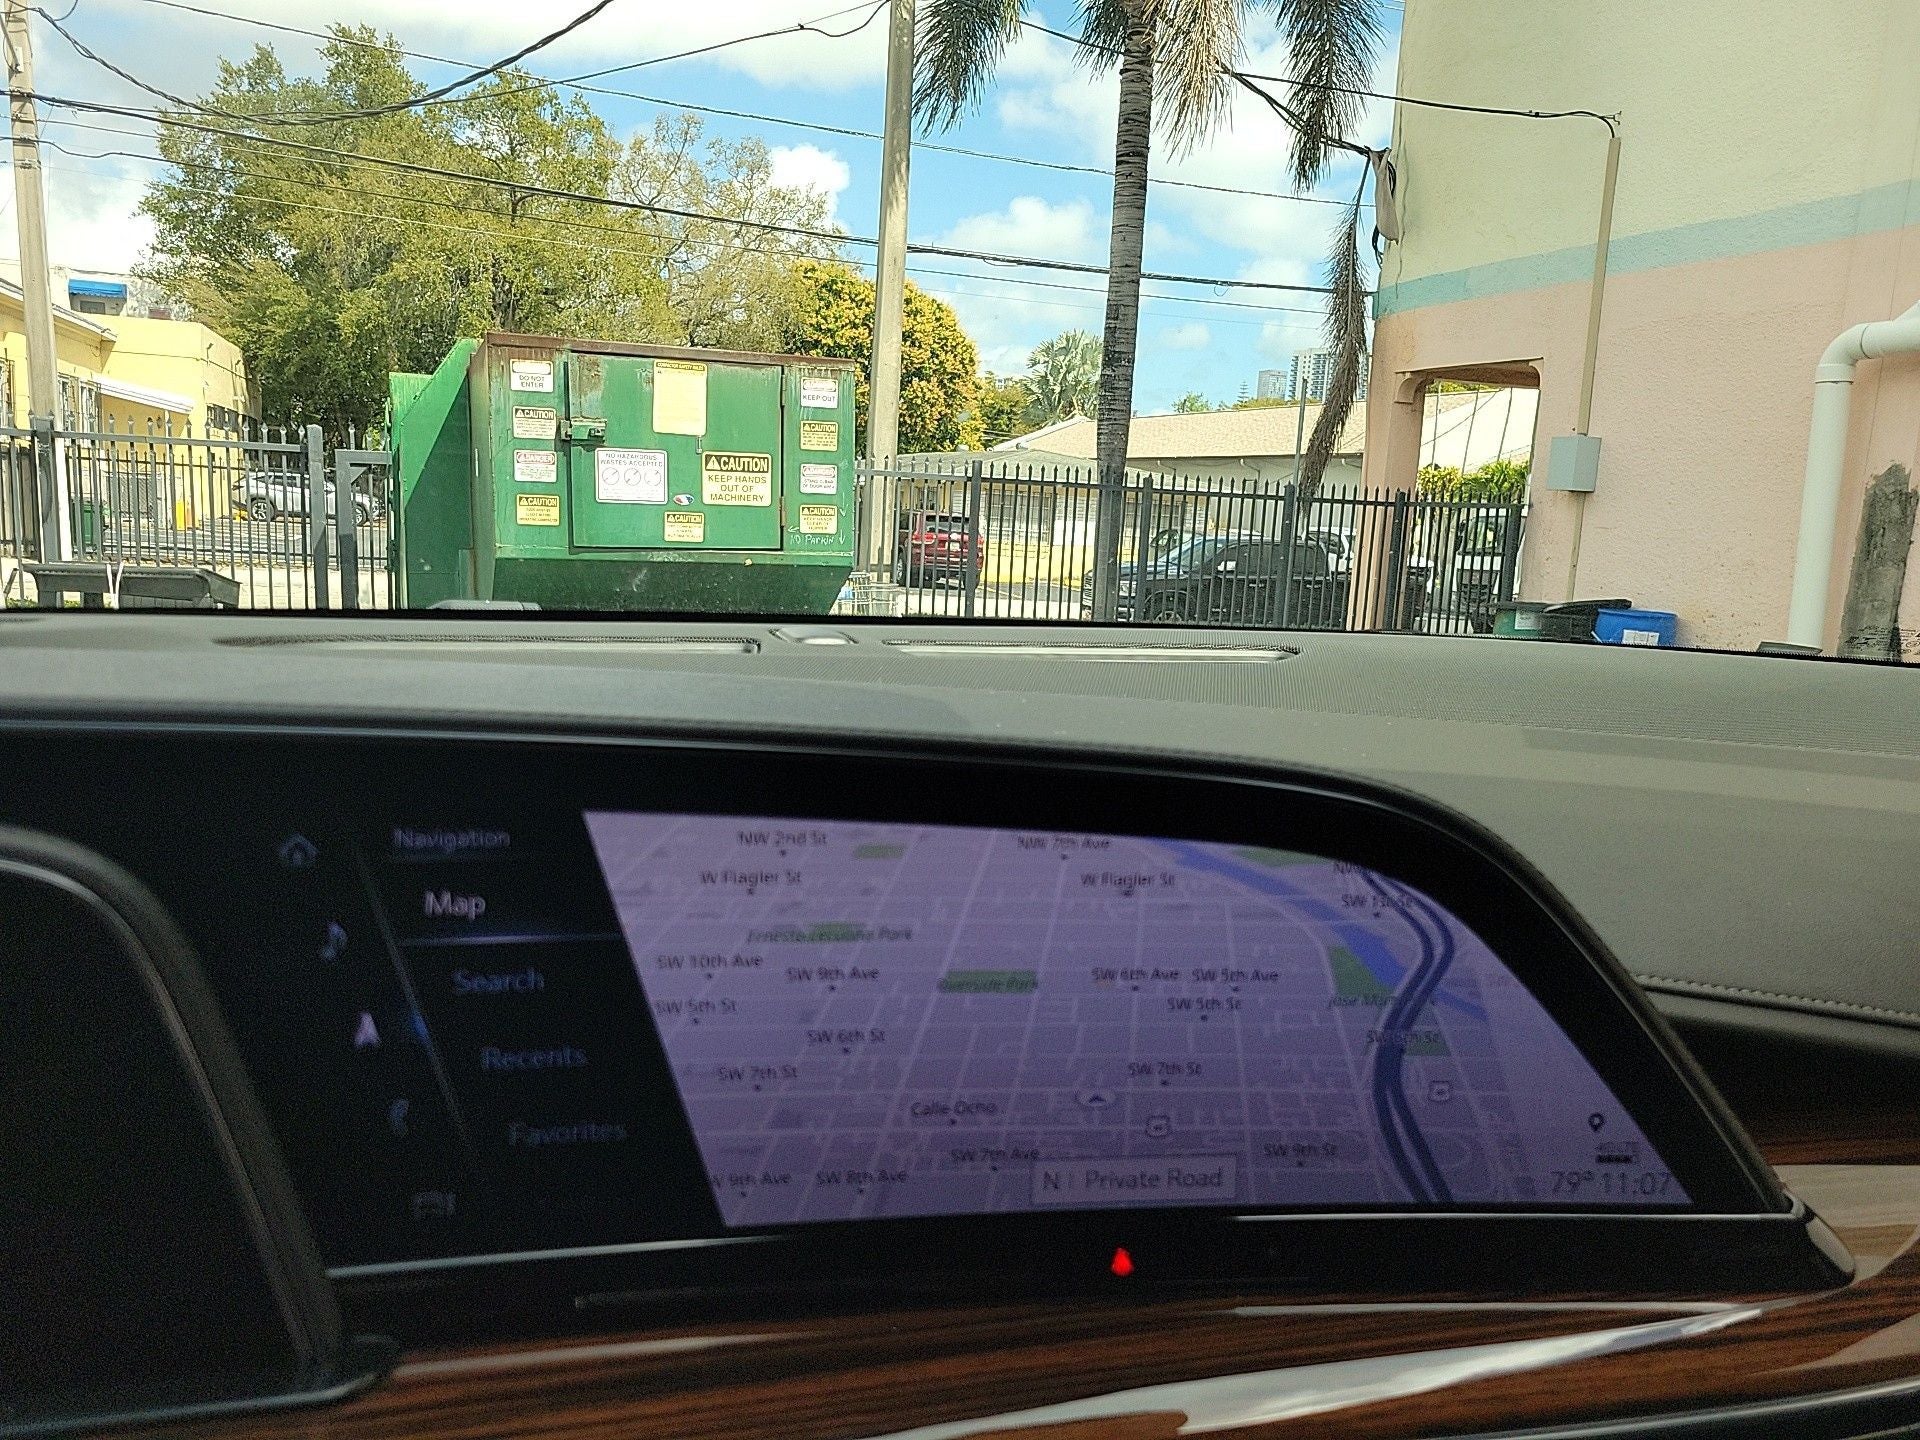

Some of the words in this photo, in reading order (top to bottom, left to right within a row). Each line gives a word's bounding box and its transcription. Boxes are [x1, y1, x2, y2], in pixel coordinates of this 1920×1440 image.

[524, 409, 554, 419] CAUTION
[810, 424, 836, 432] CAUTION
[720, 456, 768, 472] CAUTION
[707, 474, 733, 483] KEEP
[735, 475, 767, 484] HANDS
[720, 484, 740, 492] OUT
[741, 484, 754, 492] OF
[527, 497, 557, 506] CAUTION
[710, 493, 764, 502] MACHINERY
[674, 514, 702, 523] CAUTION
[809, 507, 835, 516] CAUTION
[394, 828, 511, 853] Navigation
[737, 831, 770, 846] NW
[773, 830, 807, 846] 2nd
[810, 830, 827, 846] St
[1080, 836, 1112, 850] Ave
[699, 870, 718, 884] W
[720, 869, 779, 888] Flagler
[784, 869, 803, 884] St
[1080, 873, 1097, 887] W
[1100, 871, 1155, 889] Flagler
[1159, 872, 1176, 887] St
[423, 890, 487, 920] Map
[1341, 893, 1367, 908] SW
[656, 955, 684, 970] SW
[689, 954, 727, 969] 10th
[731, 954, 765, 969] Ave
[452, 967, 546, 995] Search
[785, 967, 813, 982] SW
[817, 966, 845, 981] 9th
[849, 966, 881, 981] Ave
[1091, 967, 1118, 982] SW
[1150, 967, 1181, 981] Ave
[1191, 968, 1218, 983] SW
[1250, 968, 1279, 983] Ave
[654, 1000, 682, 1015] SW
[686, 998, 716, 1014] 5th
[720, 998, 738, 1013] St
[1166, 997, 1192, 1013] SW
[1225, 997, 1242, 1012] St
[806, 1029, 834, 1046] SW
[836, 1028, 865, 1044] 6th
[868, 1028, 886, 1043] St
[480, 1046, 588, 1072] Recents
[717, 1066, 744, 1082] SW
[749, 1065, 777, 1081] 7th
[781, 1064, 798, 1080] St
[1127, 1062, 1153, 1077] SW
[1157, 1061, 1184, 1076] 7th
[1186, 1062, 1203, 1076] St
[910, 1101, 950, 1118] Calle
[953, 1100, 999, 1116] Ocho
[508, 1122, 629, 1147] Favorites
[950, 1148, 976, 1164] SW
[979, 1147, 1007, 1162] 7th
[1010, 1146, 1041, 1161] Ave
[1263, 1142, 1289, 1158] SW
[1321, 1142, 1338, 1157] St
[760, 1171, 792, 1187] Ave
[815, 1170, 842, 1186] SW
[877, 1169, 909, 1184] Ave
[1042, 1171, 1061, 1191] N
[1085, 1168, 1161, 1191] Private
[1166, 1166, 1224, 1188] Road
[1602, 1171, 1671, 1196] 11:07
